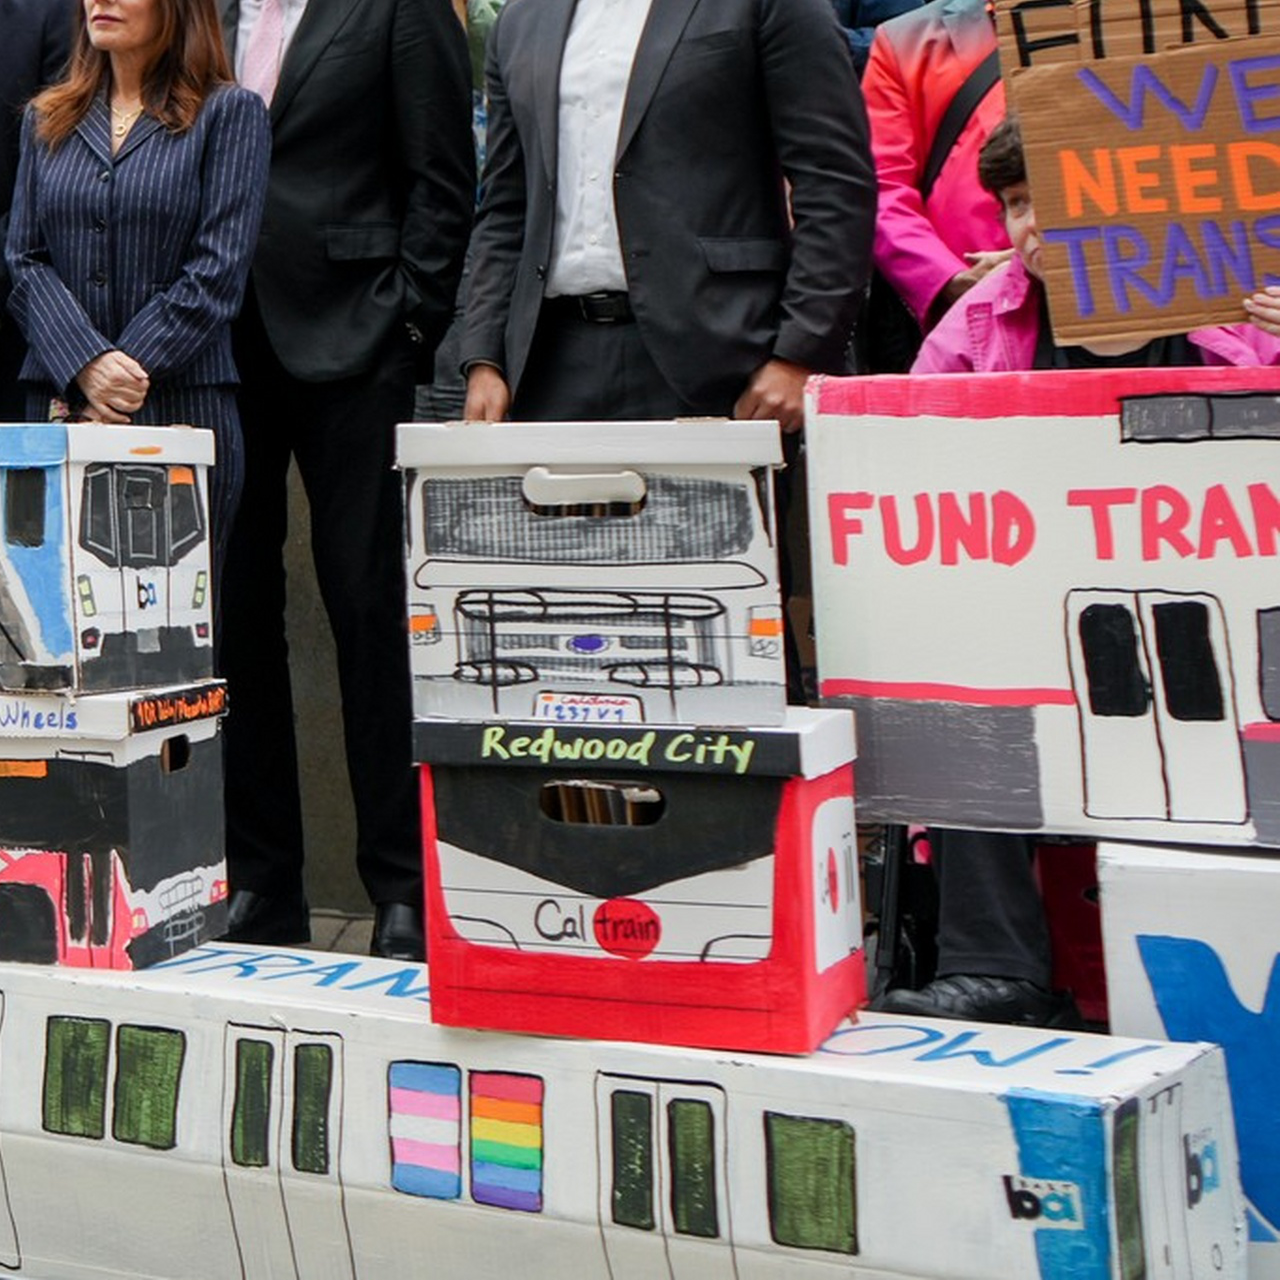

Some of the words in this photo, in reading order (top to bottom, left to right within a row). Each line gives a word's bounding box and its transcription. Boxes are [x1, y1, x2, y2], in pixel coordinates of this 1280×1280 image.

[1077, 52, 1280, 133] WE
[827, 489, 1037, 567] FUND
[481, 725, 657, 766] Redwood
[663, 732, 755, 775] City
